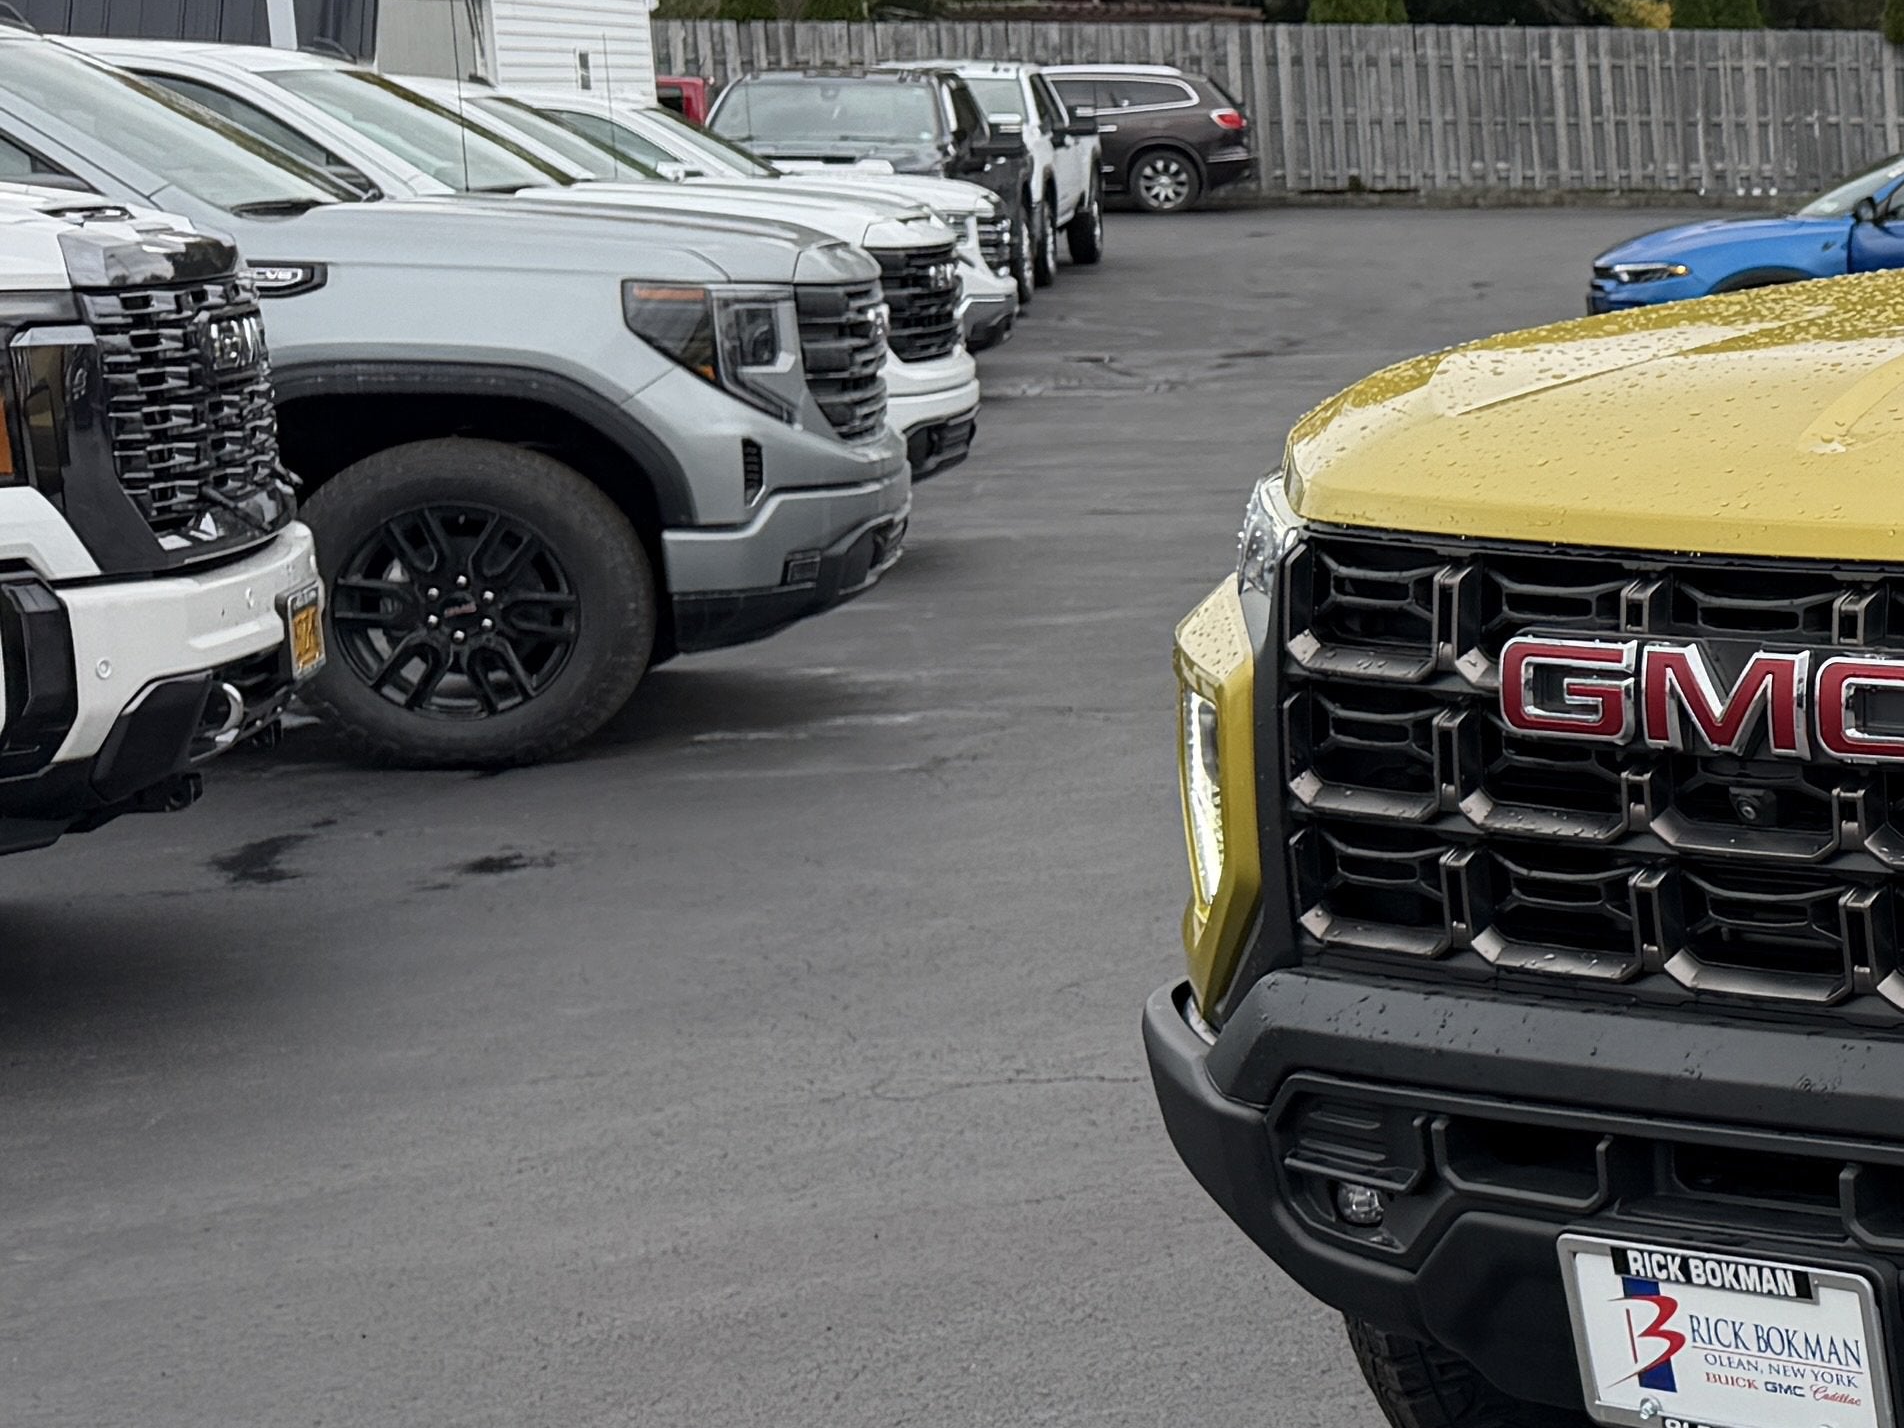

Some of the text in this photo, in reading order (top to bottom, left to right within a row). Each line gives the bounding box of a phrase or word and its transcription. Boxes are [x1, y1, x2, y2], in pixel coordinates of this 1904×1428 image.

[1626, 1249, 1797, 1297] RICK BOKMAN
[1688, 1314, 1862, 1369] RICK BOKMAN
[1704, 1354, 1859, 1389] OLEAN, NEW YORK
[1705, 1371, 1862, 1407] BUICK GMC Cadillac
